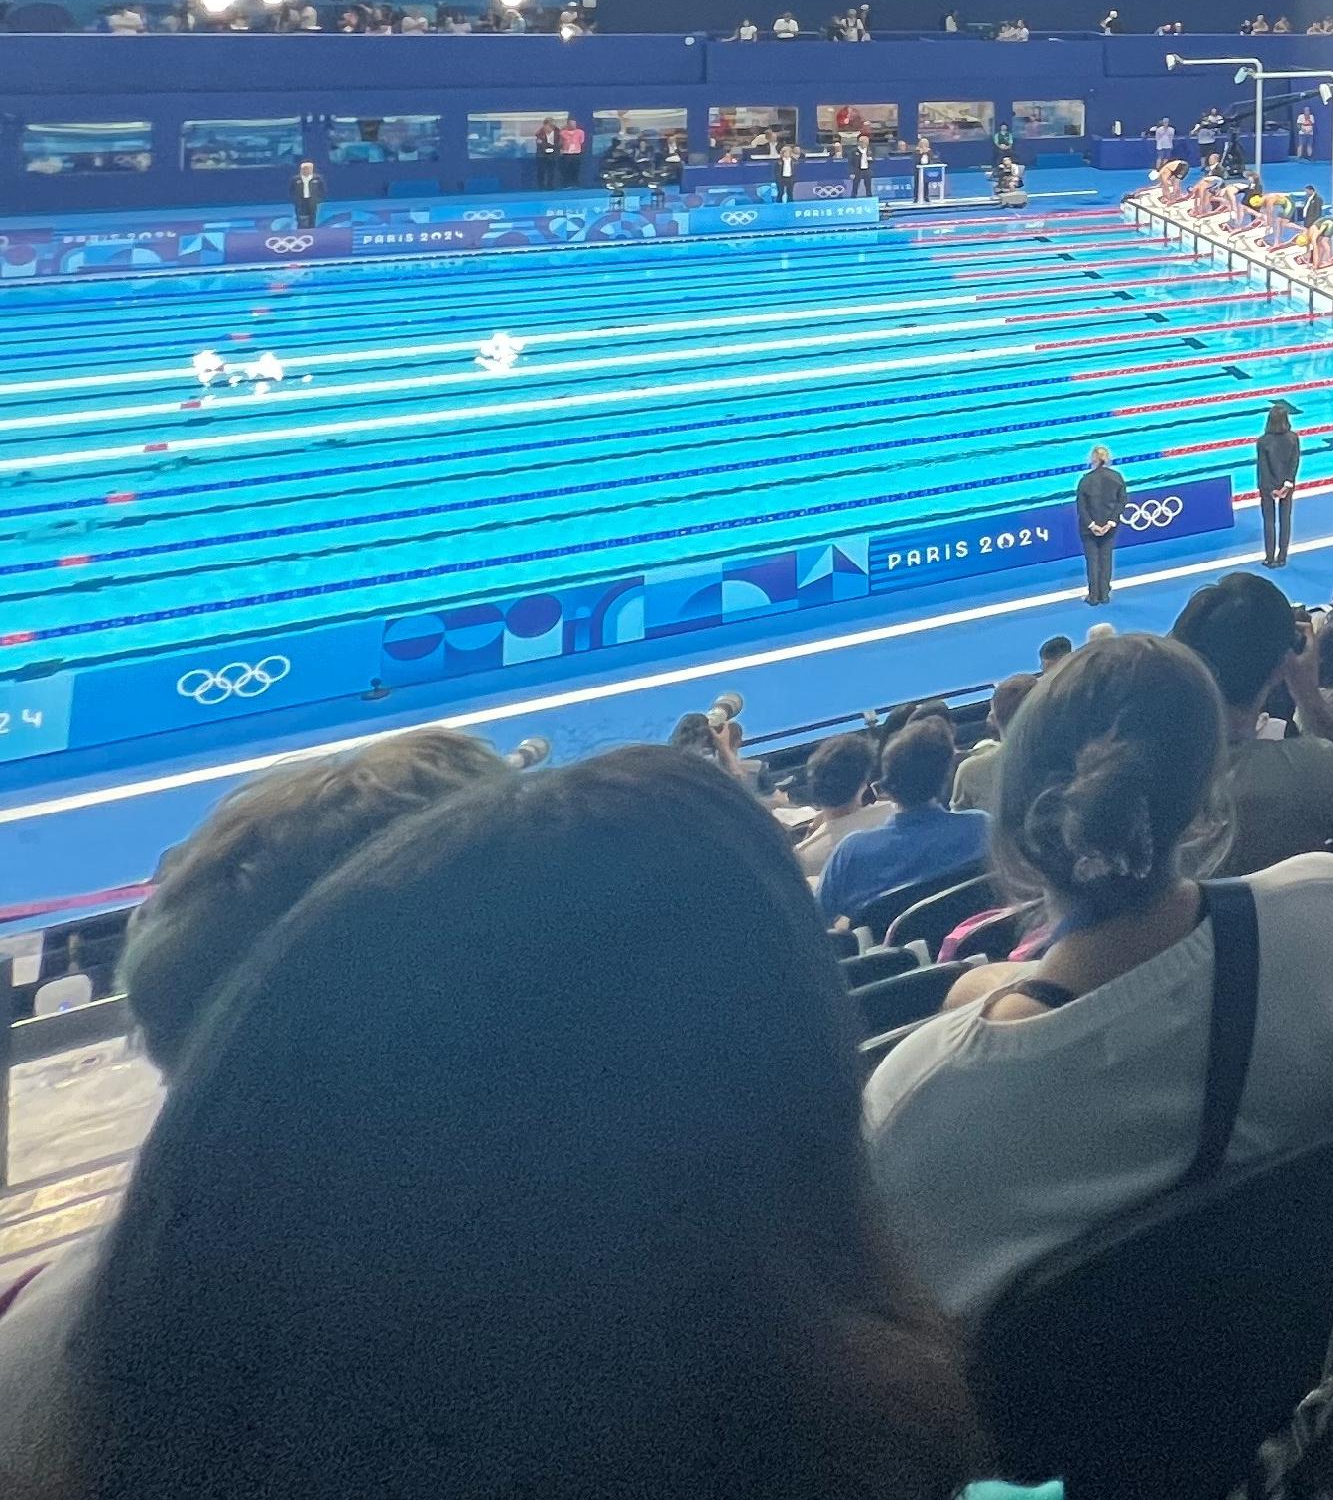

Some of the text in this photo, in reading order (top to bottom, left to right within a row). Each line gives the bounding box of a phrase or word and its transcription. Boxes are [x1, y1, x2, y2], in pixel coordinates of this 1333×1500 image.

[362, 230, 464, 244] PARIS 2024
[887, 526, 1049, 571] PARIS 2024
